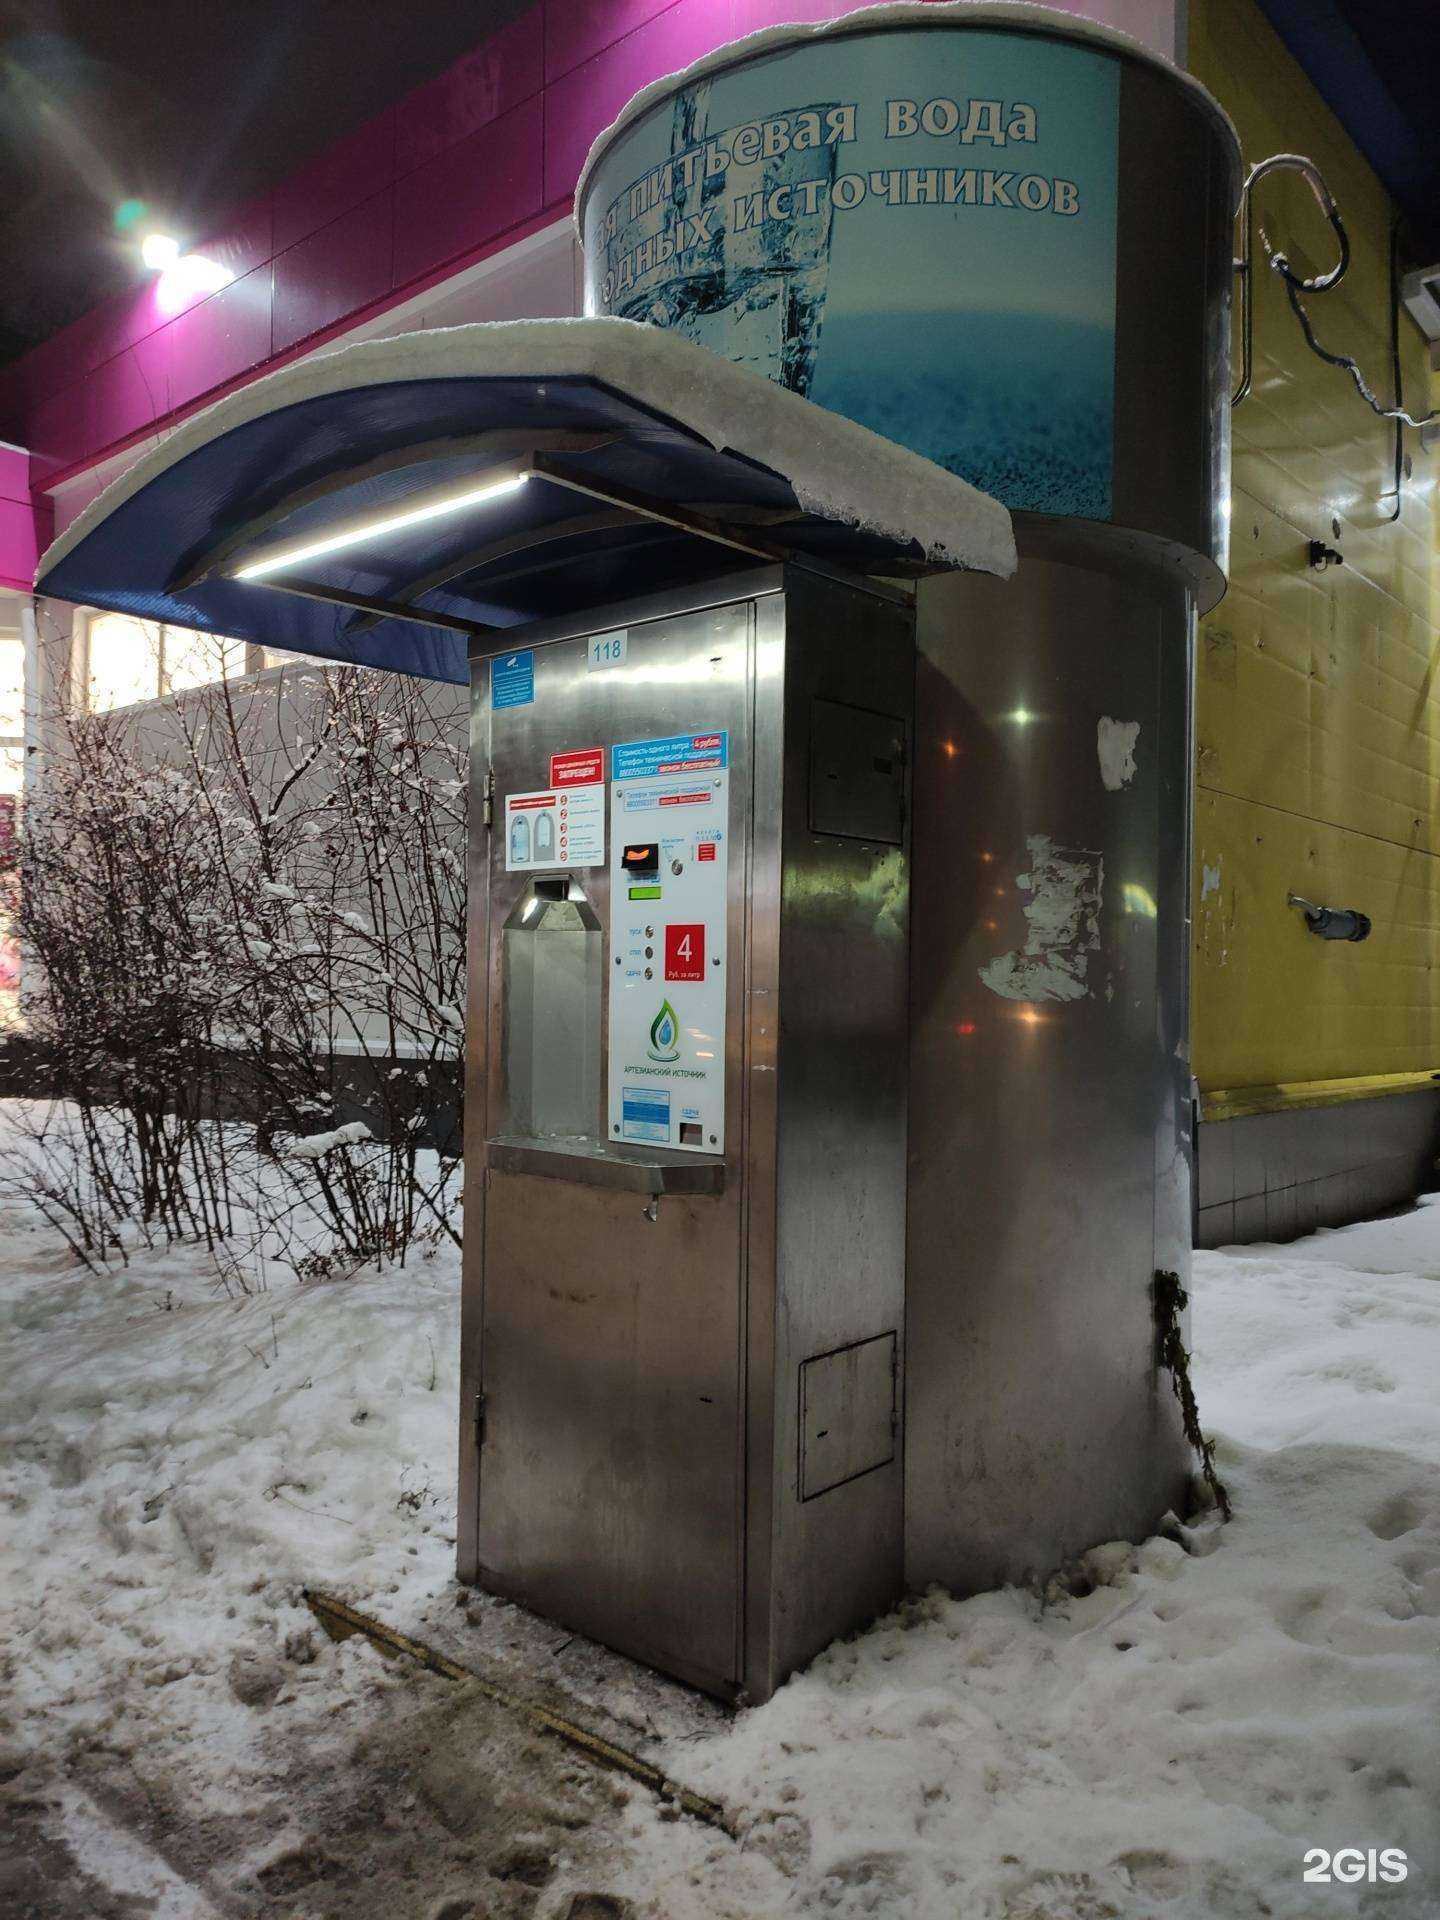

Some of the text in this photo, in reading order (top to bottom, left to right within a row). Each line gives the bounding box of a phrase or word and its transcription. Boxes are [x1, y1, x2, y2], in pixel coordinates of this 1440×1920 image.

[628, 103, 858, 224] питьевая
[885, 98, 1038, 147] вода
[733, 168, 1080, 233] источников
[593, 640, 621, 661] 118
[677, 934, 692, 962] 4
[624, 1065, 706, 1079] АРТЕЗИАНСКИЙ ИСТОЧНИК
